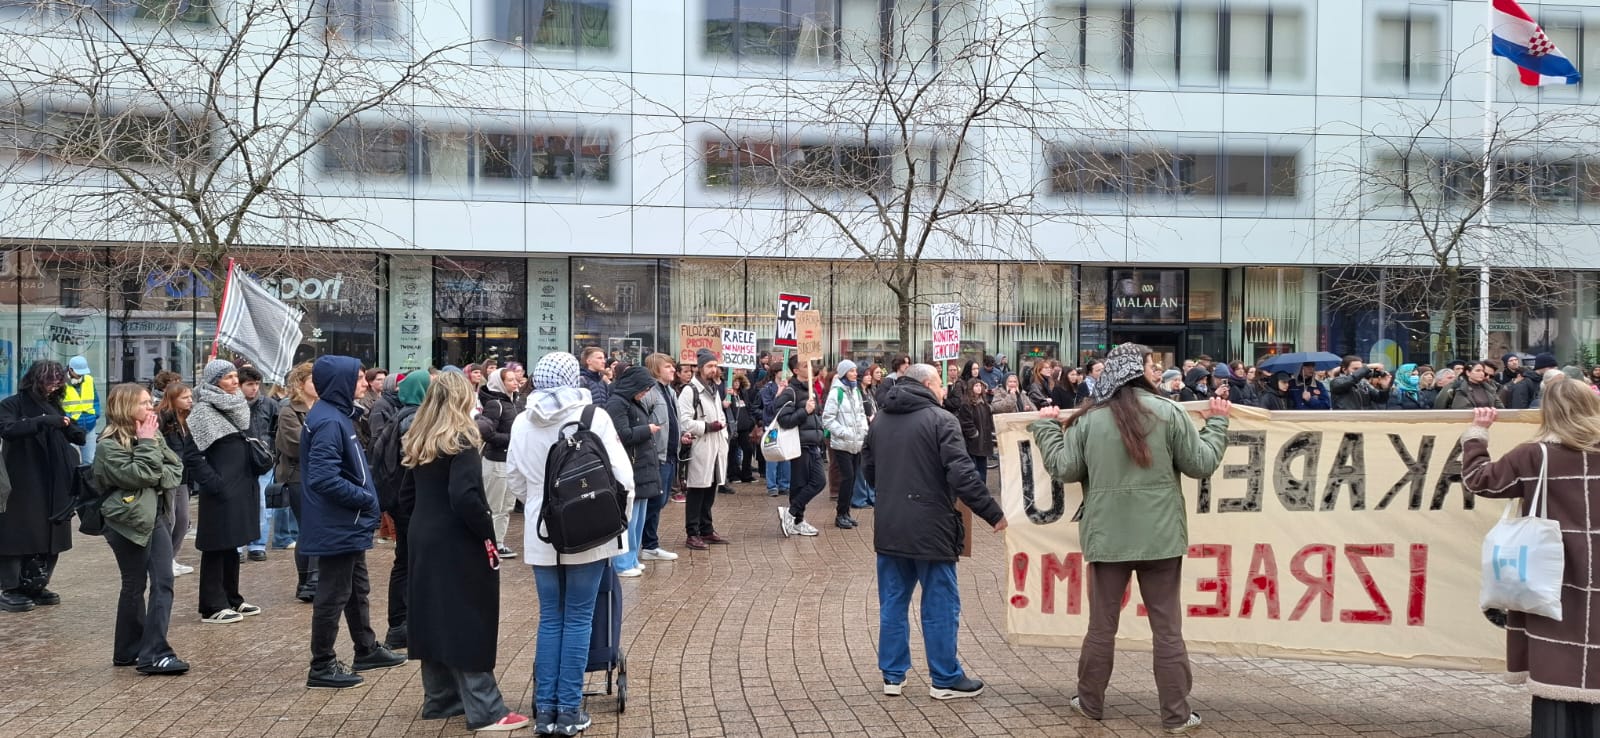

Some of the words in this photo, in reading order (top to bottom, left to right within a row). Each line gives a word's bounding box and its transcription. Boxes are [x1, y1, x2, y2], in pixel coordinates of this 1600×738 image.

[1115, 297, 1178, 308] MALALAN
[937, 316, 955, 330] ALU
[50, 324, 90, 337] FITNESS
[778, 320, 796, 340] WA
[933, 330, 958, 343] KONTRA
[52, 333, 85, 346] KING
